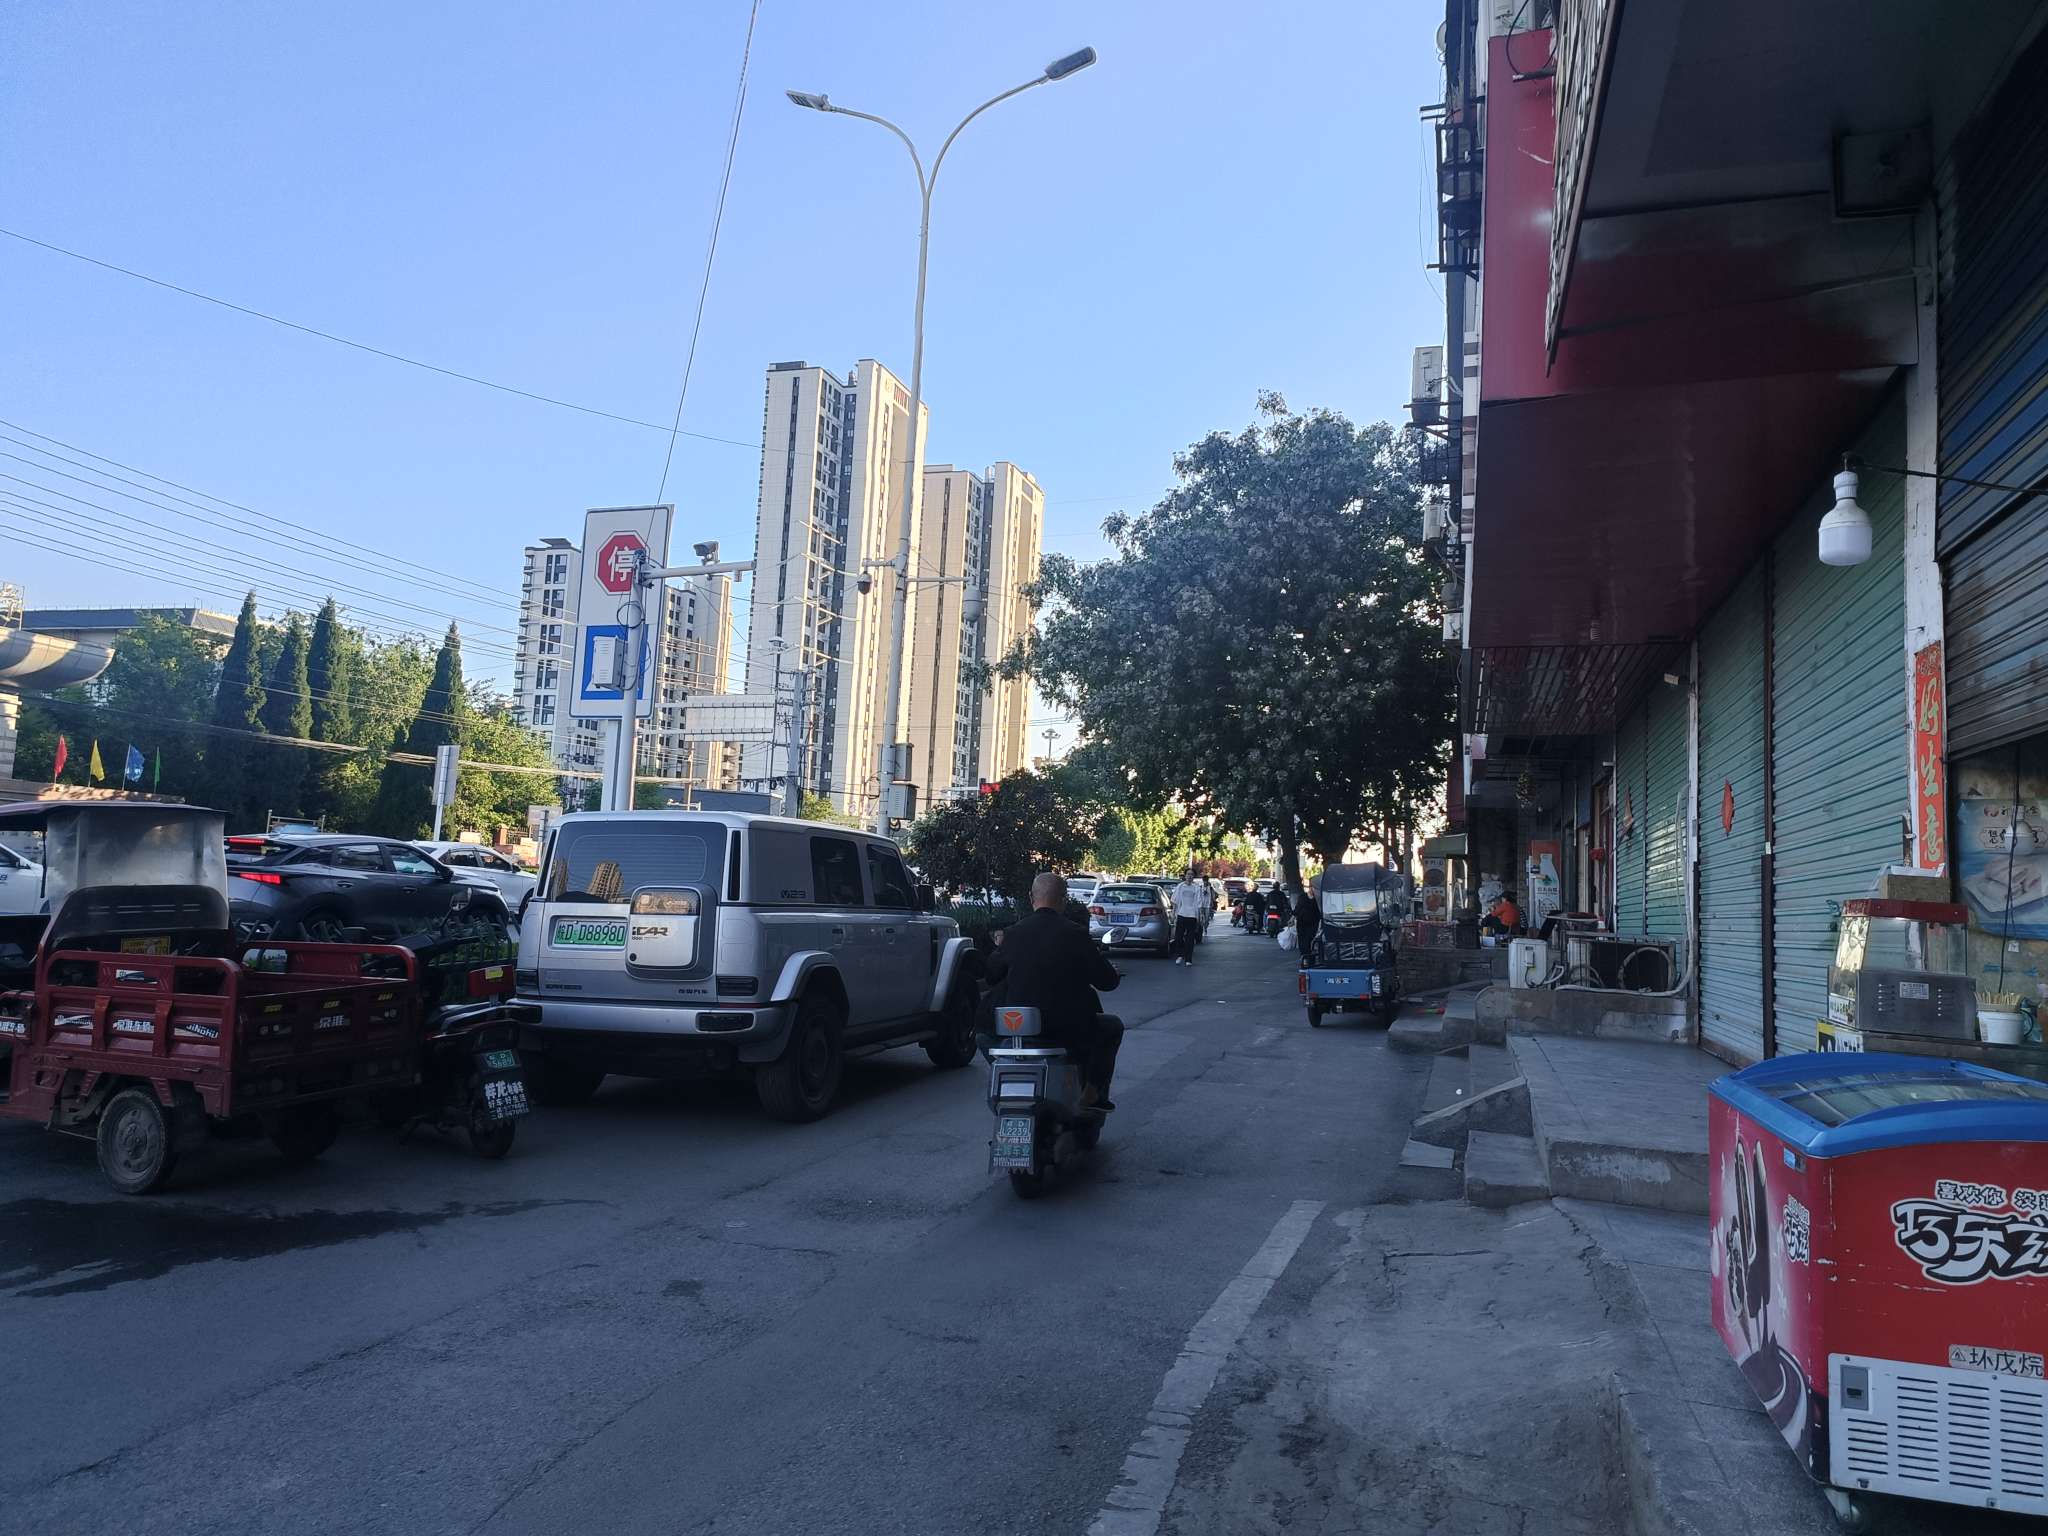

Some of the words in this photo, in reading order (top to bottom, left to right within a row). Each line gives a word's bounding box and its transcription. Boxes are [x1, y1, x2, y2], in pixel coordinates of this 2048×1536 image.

[608, 546, 637, 582] 停
[1937, 1181, 2004, 1206] 喜欢你
